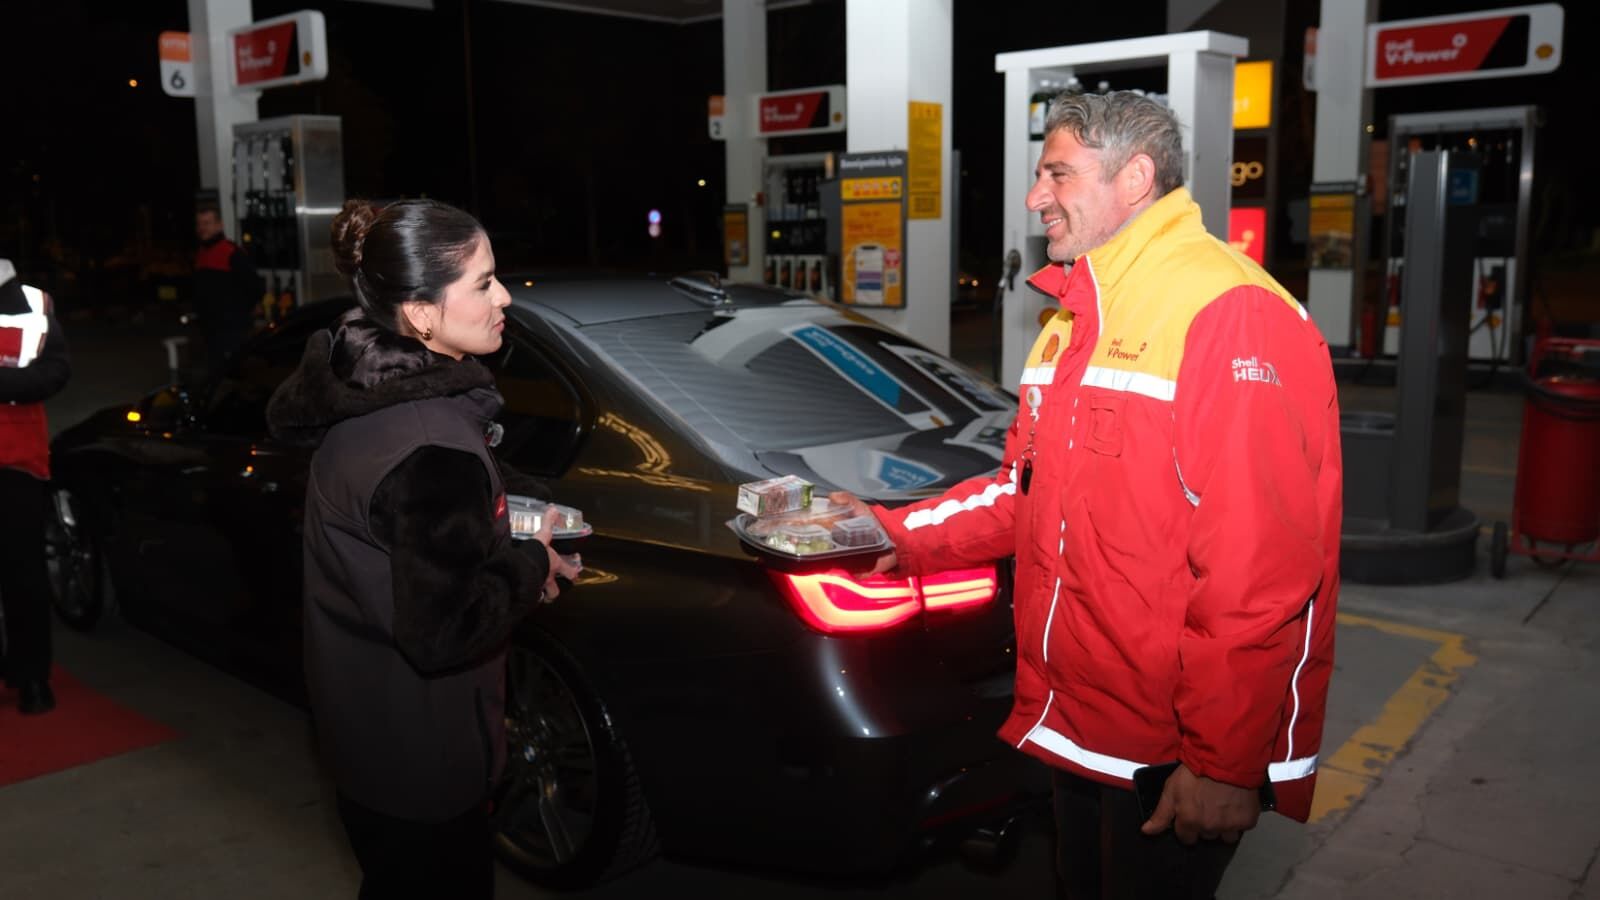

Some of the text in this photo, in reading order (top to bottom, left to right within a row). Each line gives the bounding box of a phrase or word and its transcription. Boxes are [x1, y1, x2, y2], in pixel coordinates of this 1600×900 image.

[1384, 47, 1461, 66] V-Power
[171, 70, 185, 90] 6
[1231, 356, 1258, 369] Shell
